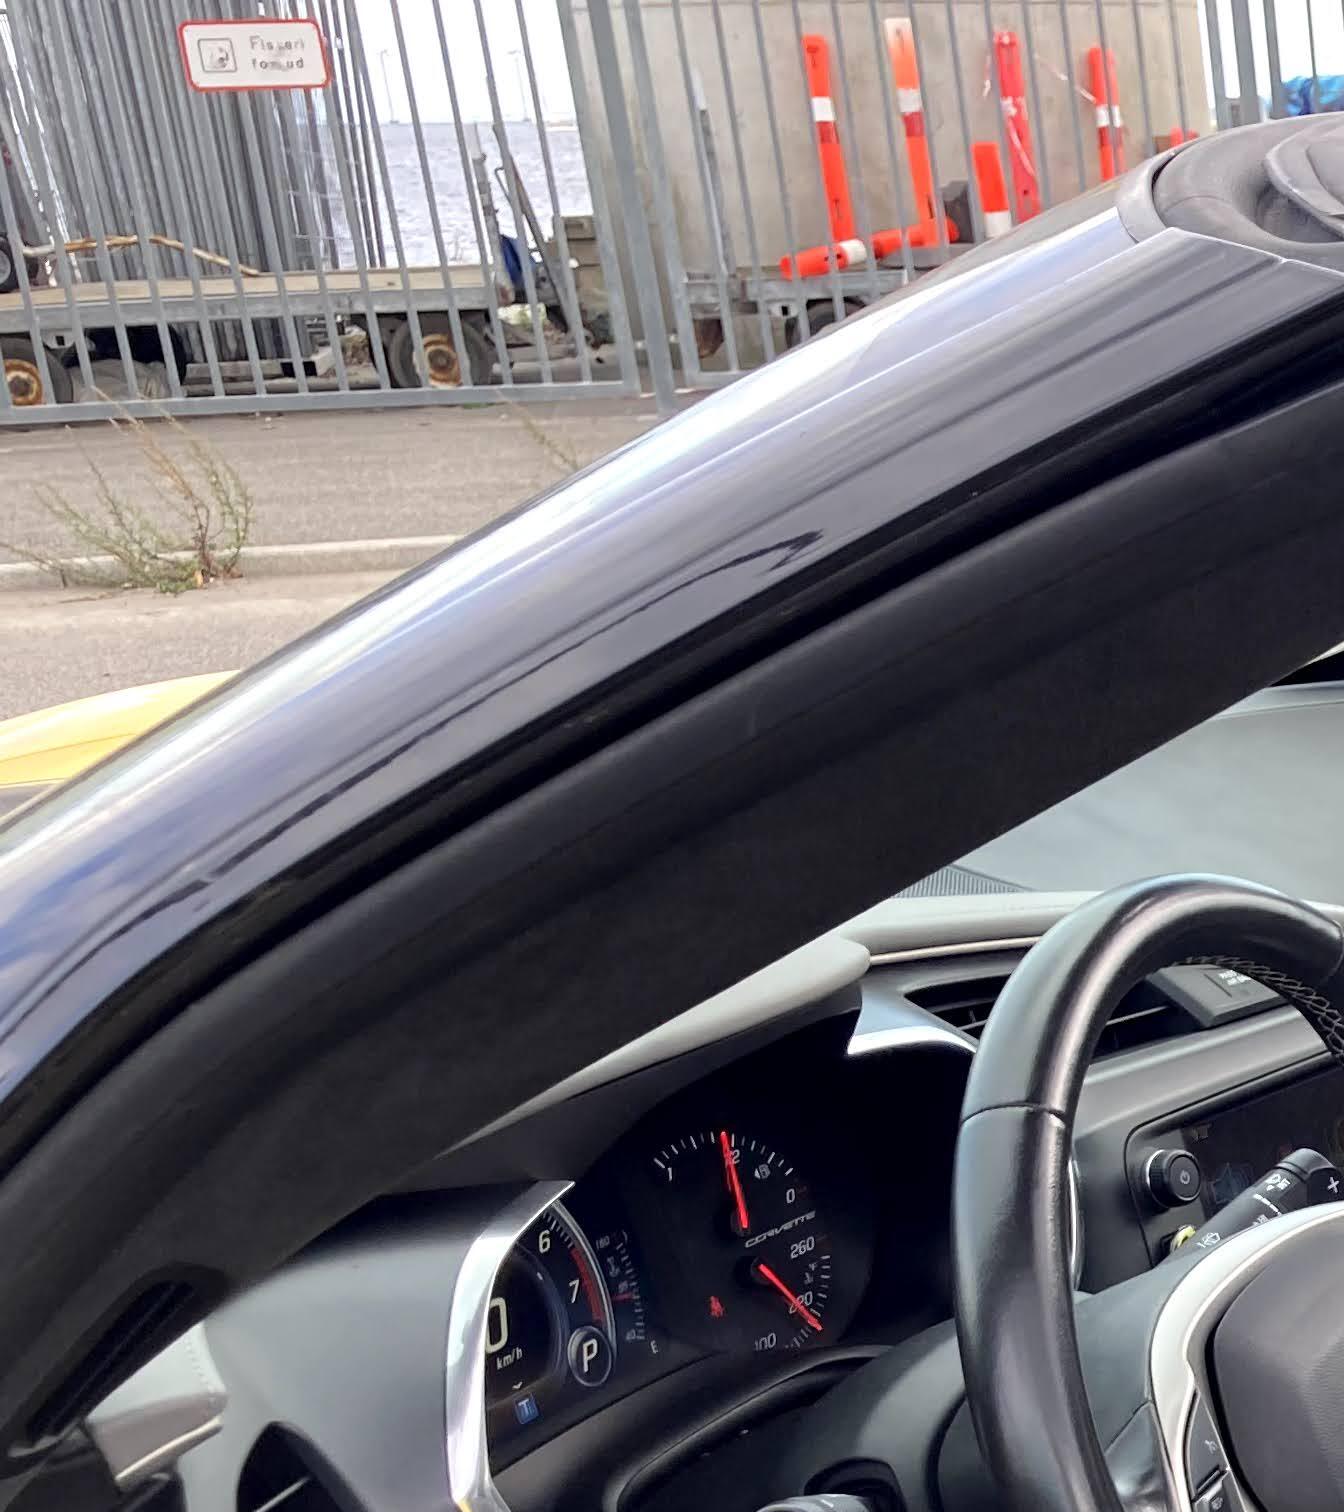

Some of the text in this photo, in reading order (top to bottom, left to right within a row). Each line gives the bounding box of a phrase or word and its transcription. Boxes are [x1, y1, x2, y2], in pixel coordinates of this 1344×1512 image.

[786, 1188, 796, 1204] 0
[538, 1229, 552, 1254] 6
[790, 1236, 815, 1260] 260
[568, 1278, 580, 1304] 7
[496, 1346, 523, 1371] km/h
[581, 1338, 598, 1373] P
